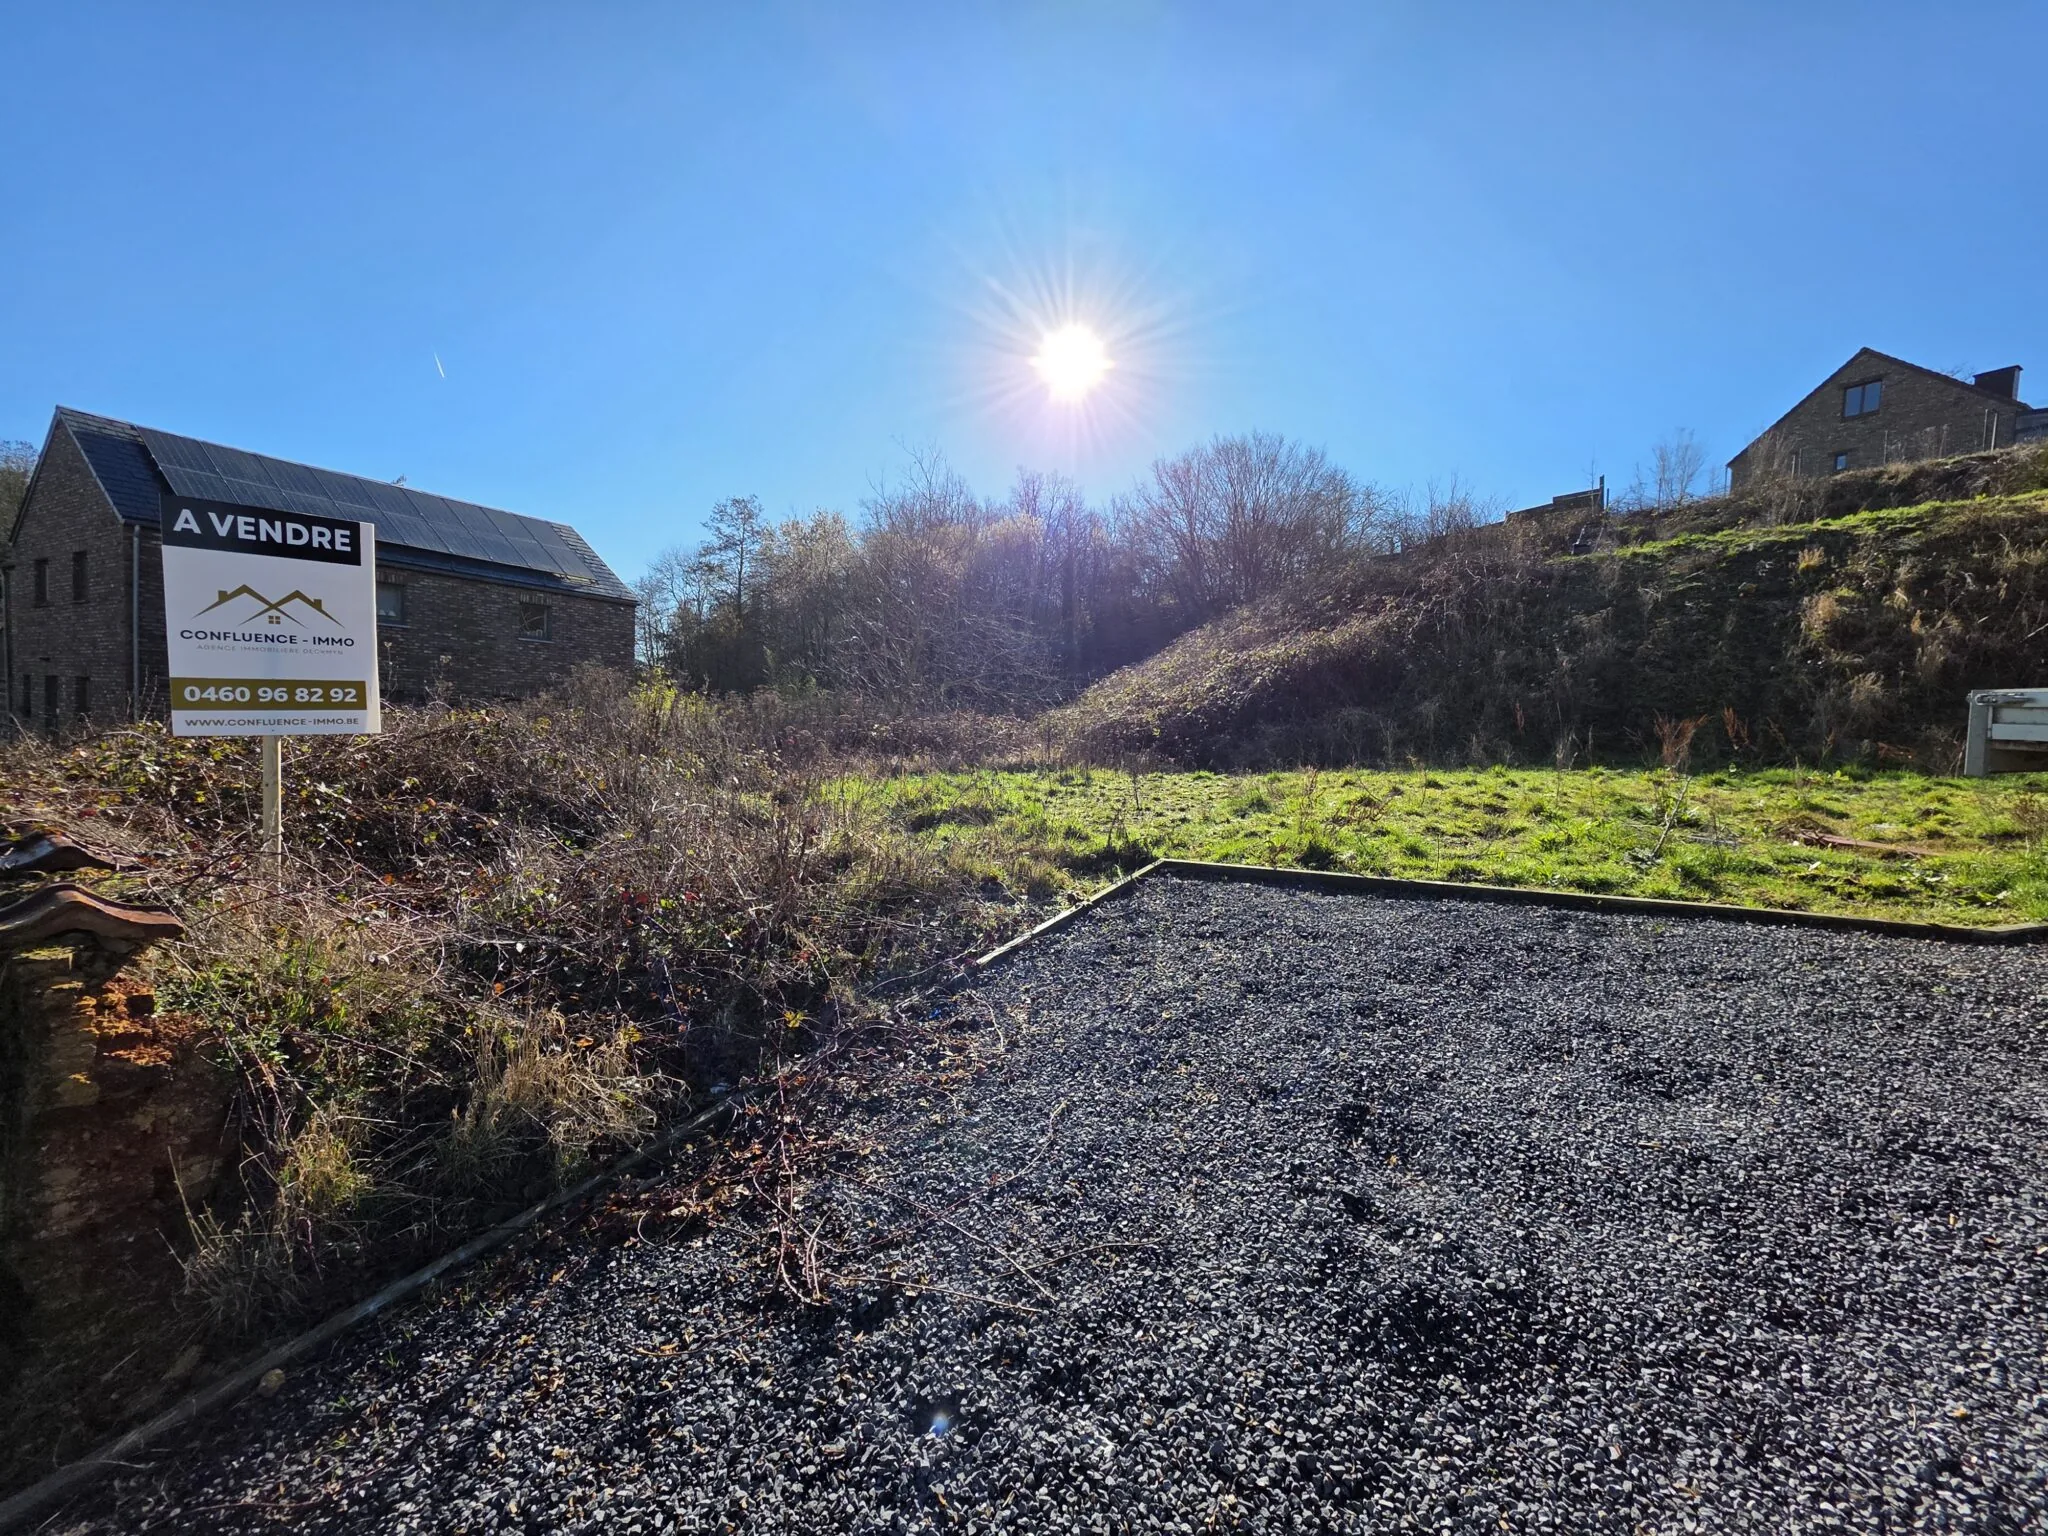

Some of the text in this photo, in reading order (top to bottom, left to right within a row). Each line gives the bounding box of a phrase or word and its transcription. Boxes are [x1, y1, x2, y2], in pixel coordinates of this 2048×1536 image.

[173, 508, 351, 552] A VENDRE
[180, 629, 298, 645] CONFLUENCE
[312, 636, 355, 647] IMMO
[183, 685, 358, 702] 0460 96 82 92
[185, 717, 359, 727] WWW.CONFLUENCE-IMMO.BE
